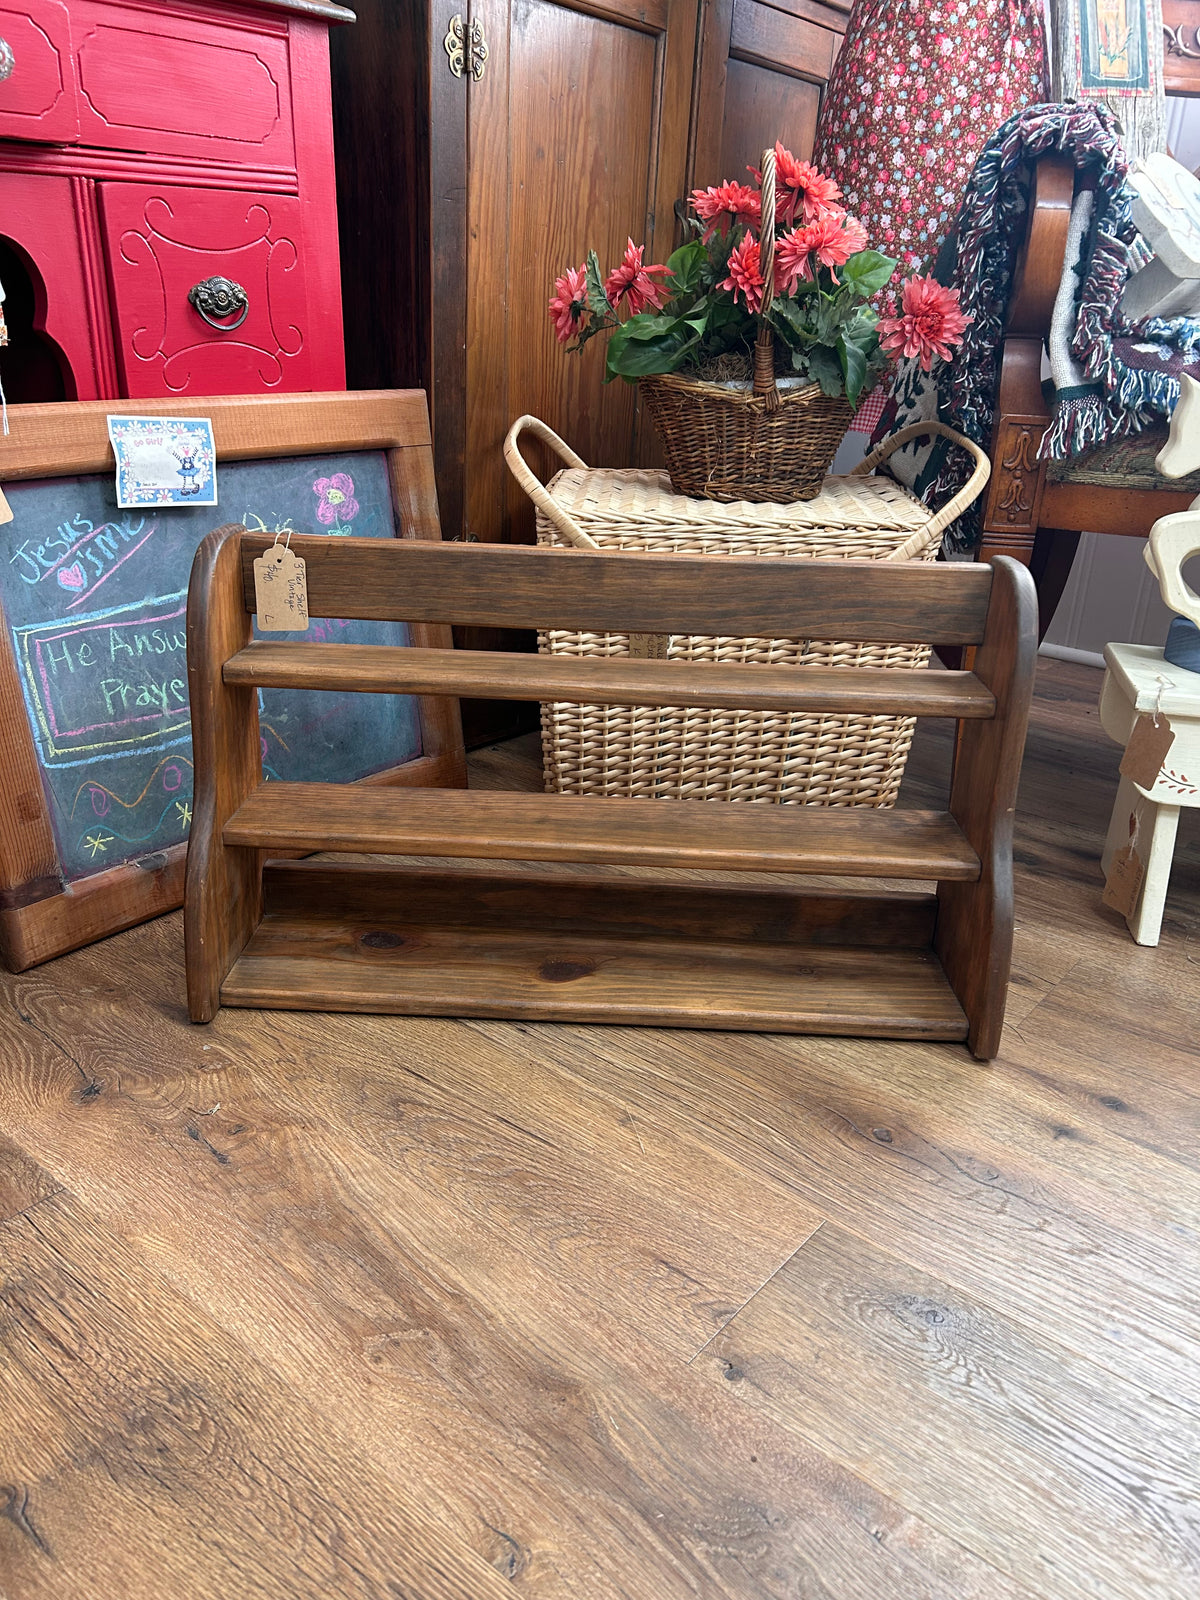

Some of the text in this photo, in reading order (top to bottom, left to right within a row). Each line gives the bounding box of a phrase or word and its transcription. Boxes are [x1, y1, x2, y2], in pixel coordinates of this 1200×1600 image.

[9, 512, 95, 585] Jesus
[284, 579, 294, 610] Vintage
[295, 570, 304, 588] Tier
[297, 594, 306, 620] Shelf
[45, 627, 187, 674] He Answ
[100, 678, 187, 719] Praye
